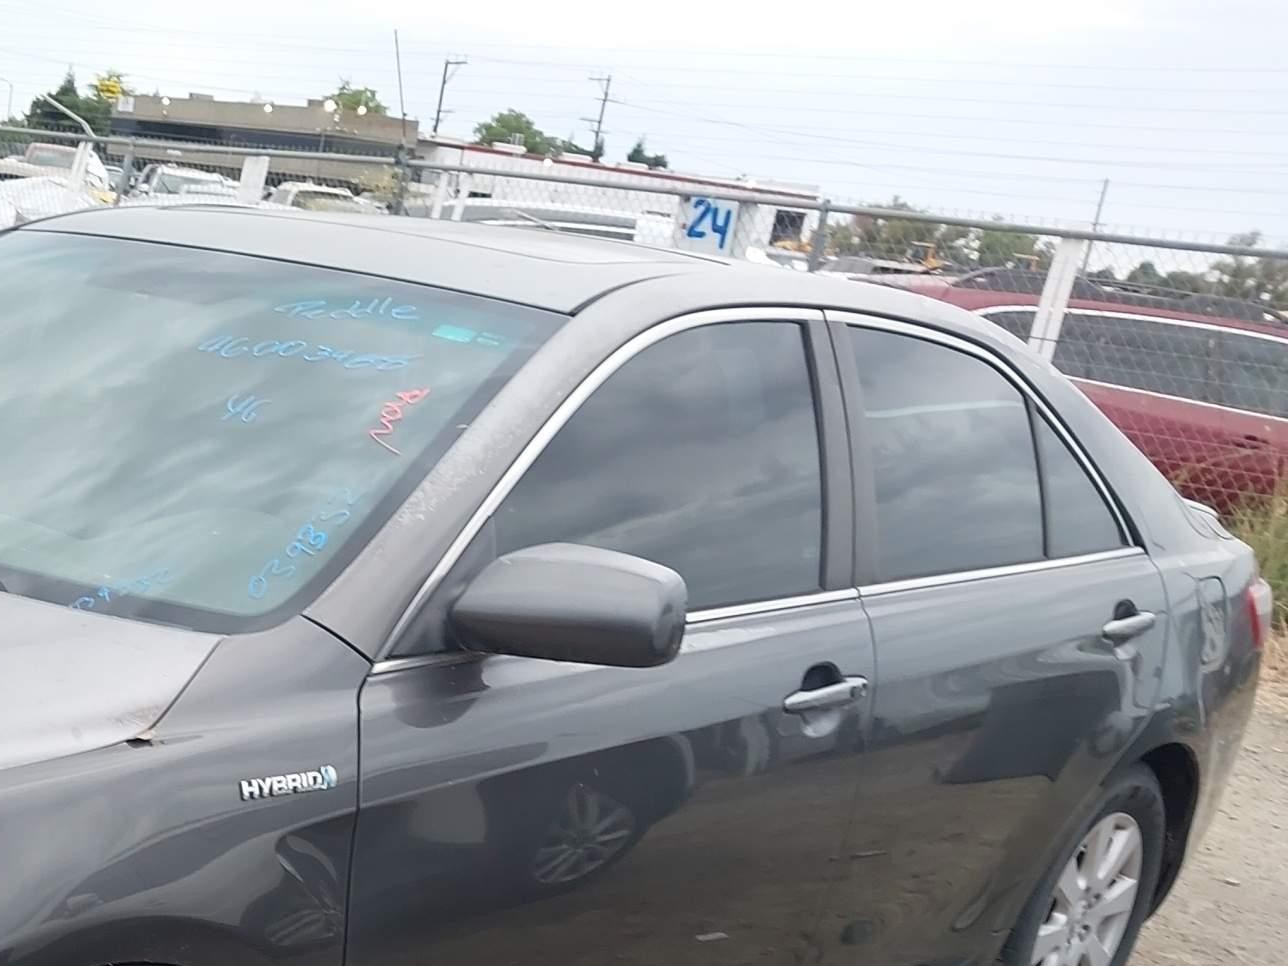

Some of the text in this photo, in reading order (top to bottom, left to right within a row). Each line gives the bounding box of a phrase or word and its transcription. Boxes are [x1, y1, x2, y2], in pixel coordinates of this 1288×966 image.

[686, 198, 732, 250] 24
[221, 393, 272, 423] 46
[240, 771, 323, 800] HYBRID
